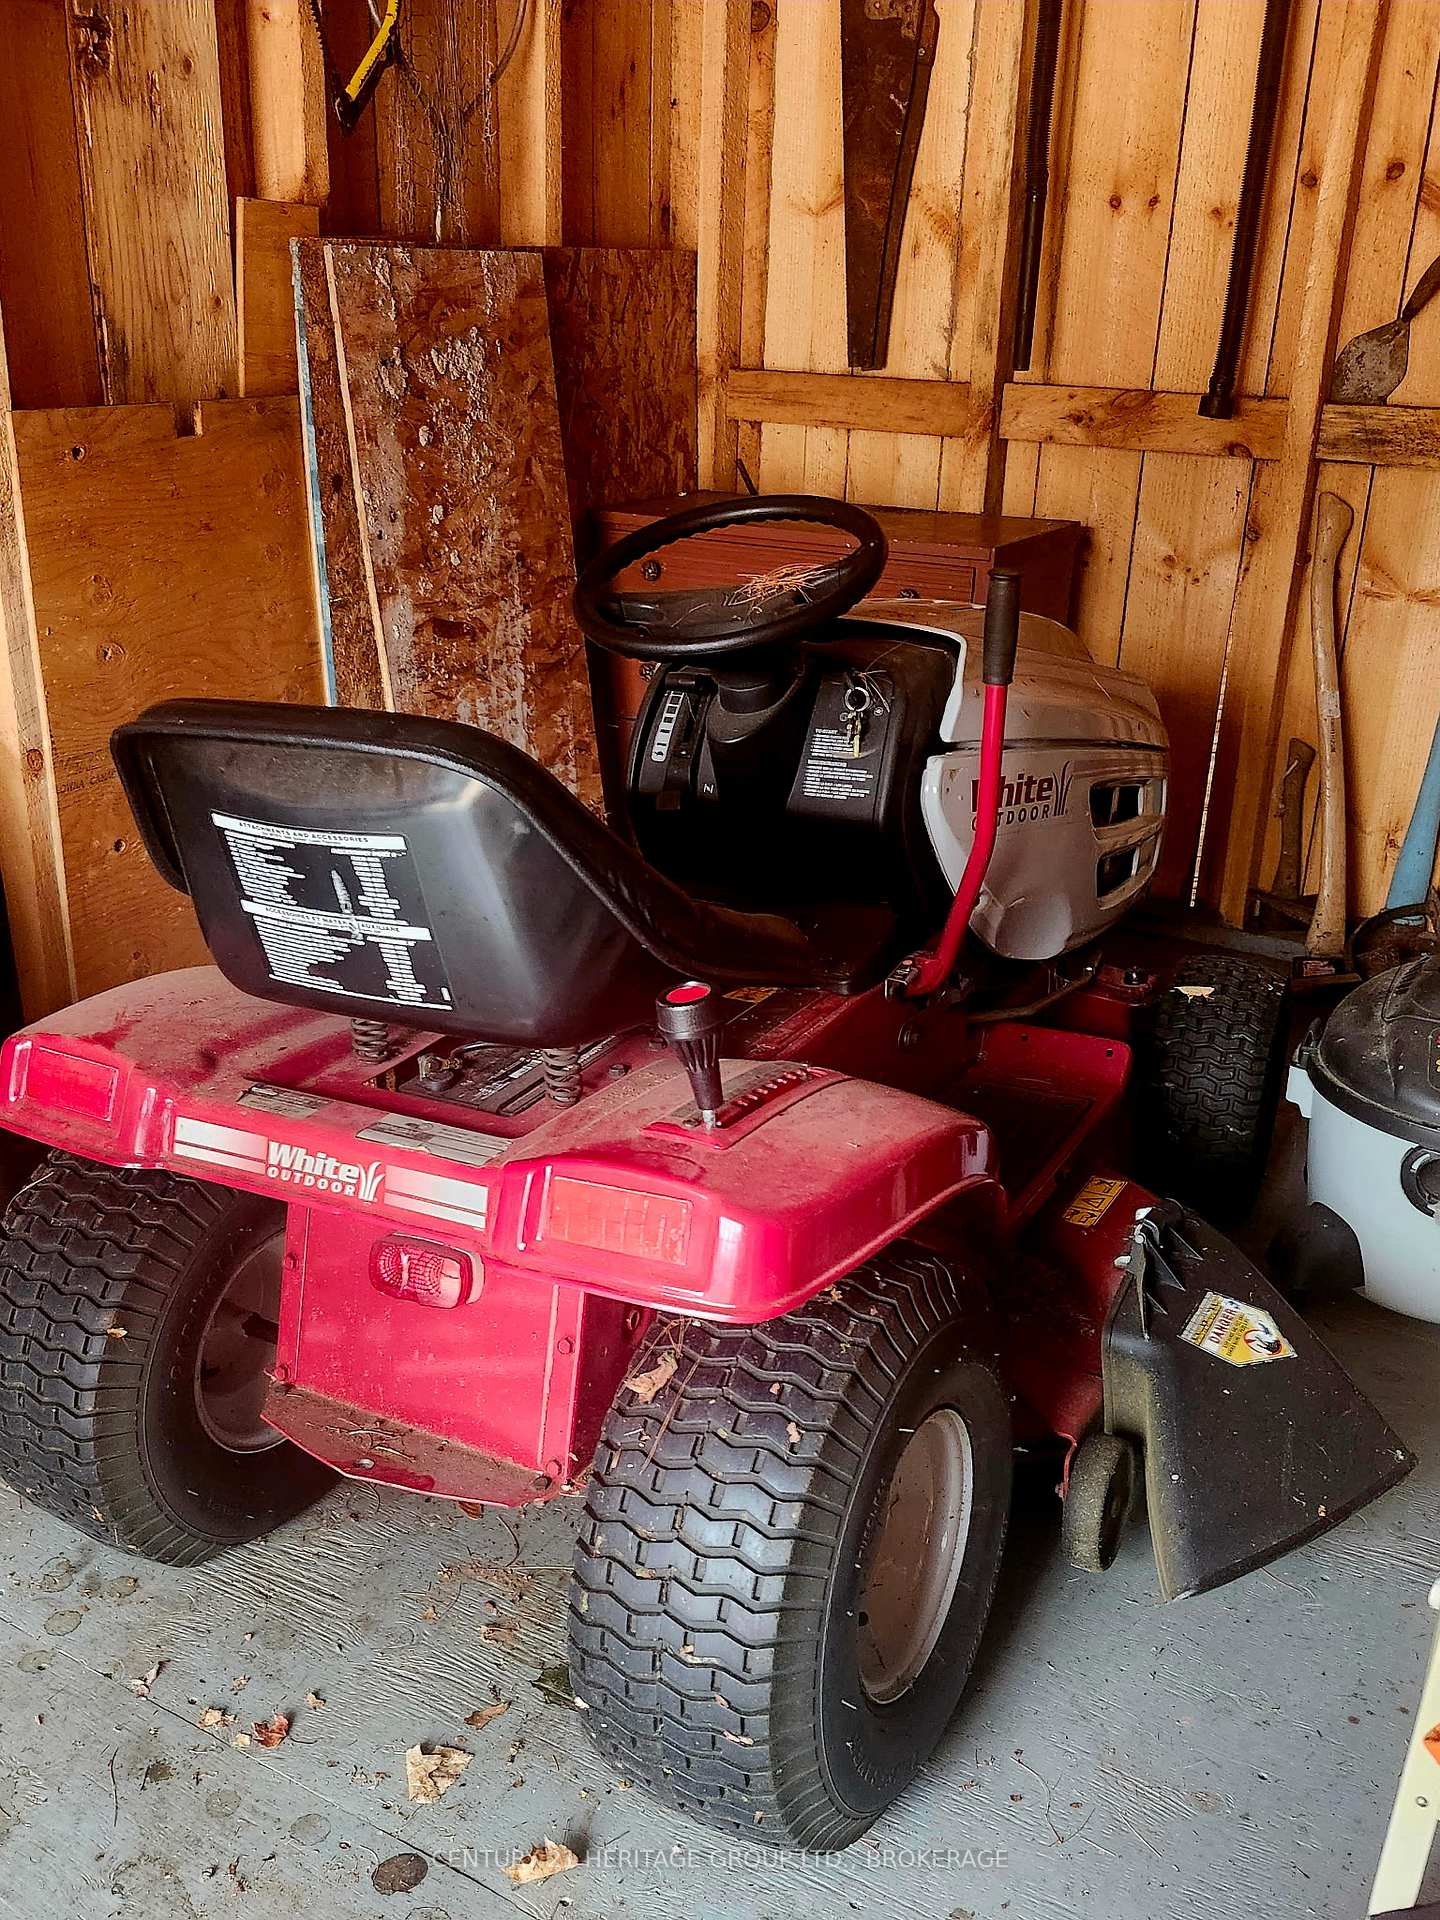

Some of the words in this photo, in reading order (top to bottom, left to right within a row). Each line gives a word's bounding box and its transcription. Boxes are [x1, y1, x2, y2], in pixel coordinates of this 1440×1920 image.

[702, 783, 715, 794] N
[971, 773, 1054, 813] hite
[971, 804, 1050, 832] TDOOR
[292, 831, 309, 839] AND
[311, 832, 370, 843] ACCESSORIES
[267, 1140, 360, 1184] White
[266, 1165, 356, 1197] OUTDOOR
[1206, 1306, 1238, 1345] DANGER
